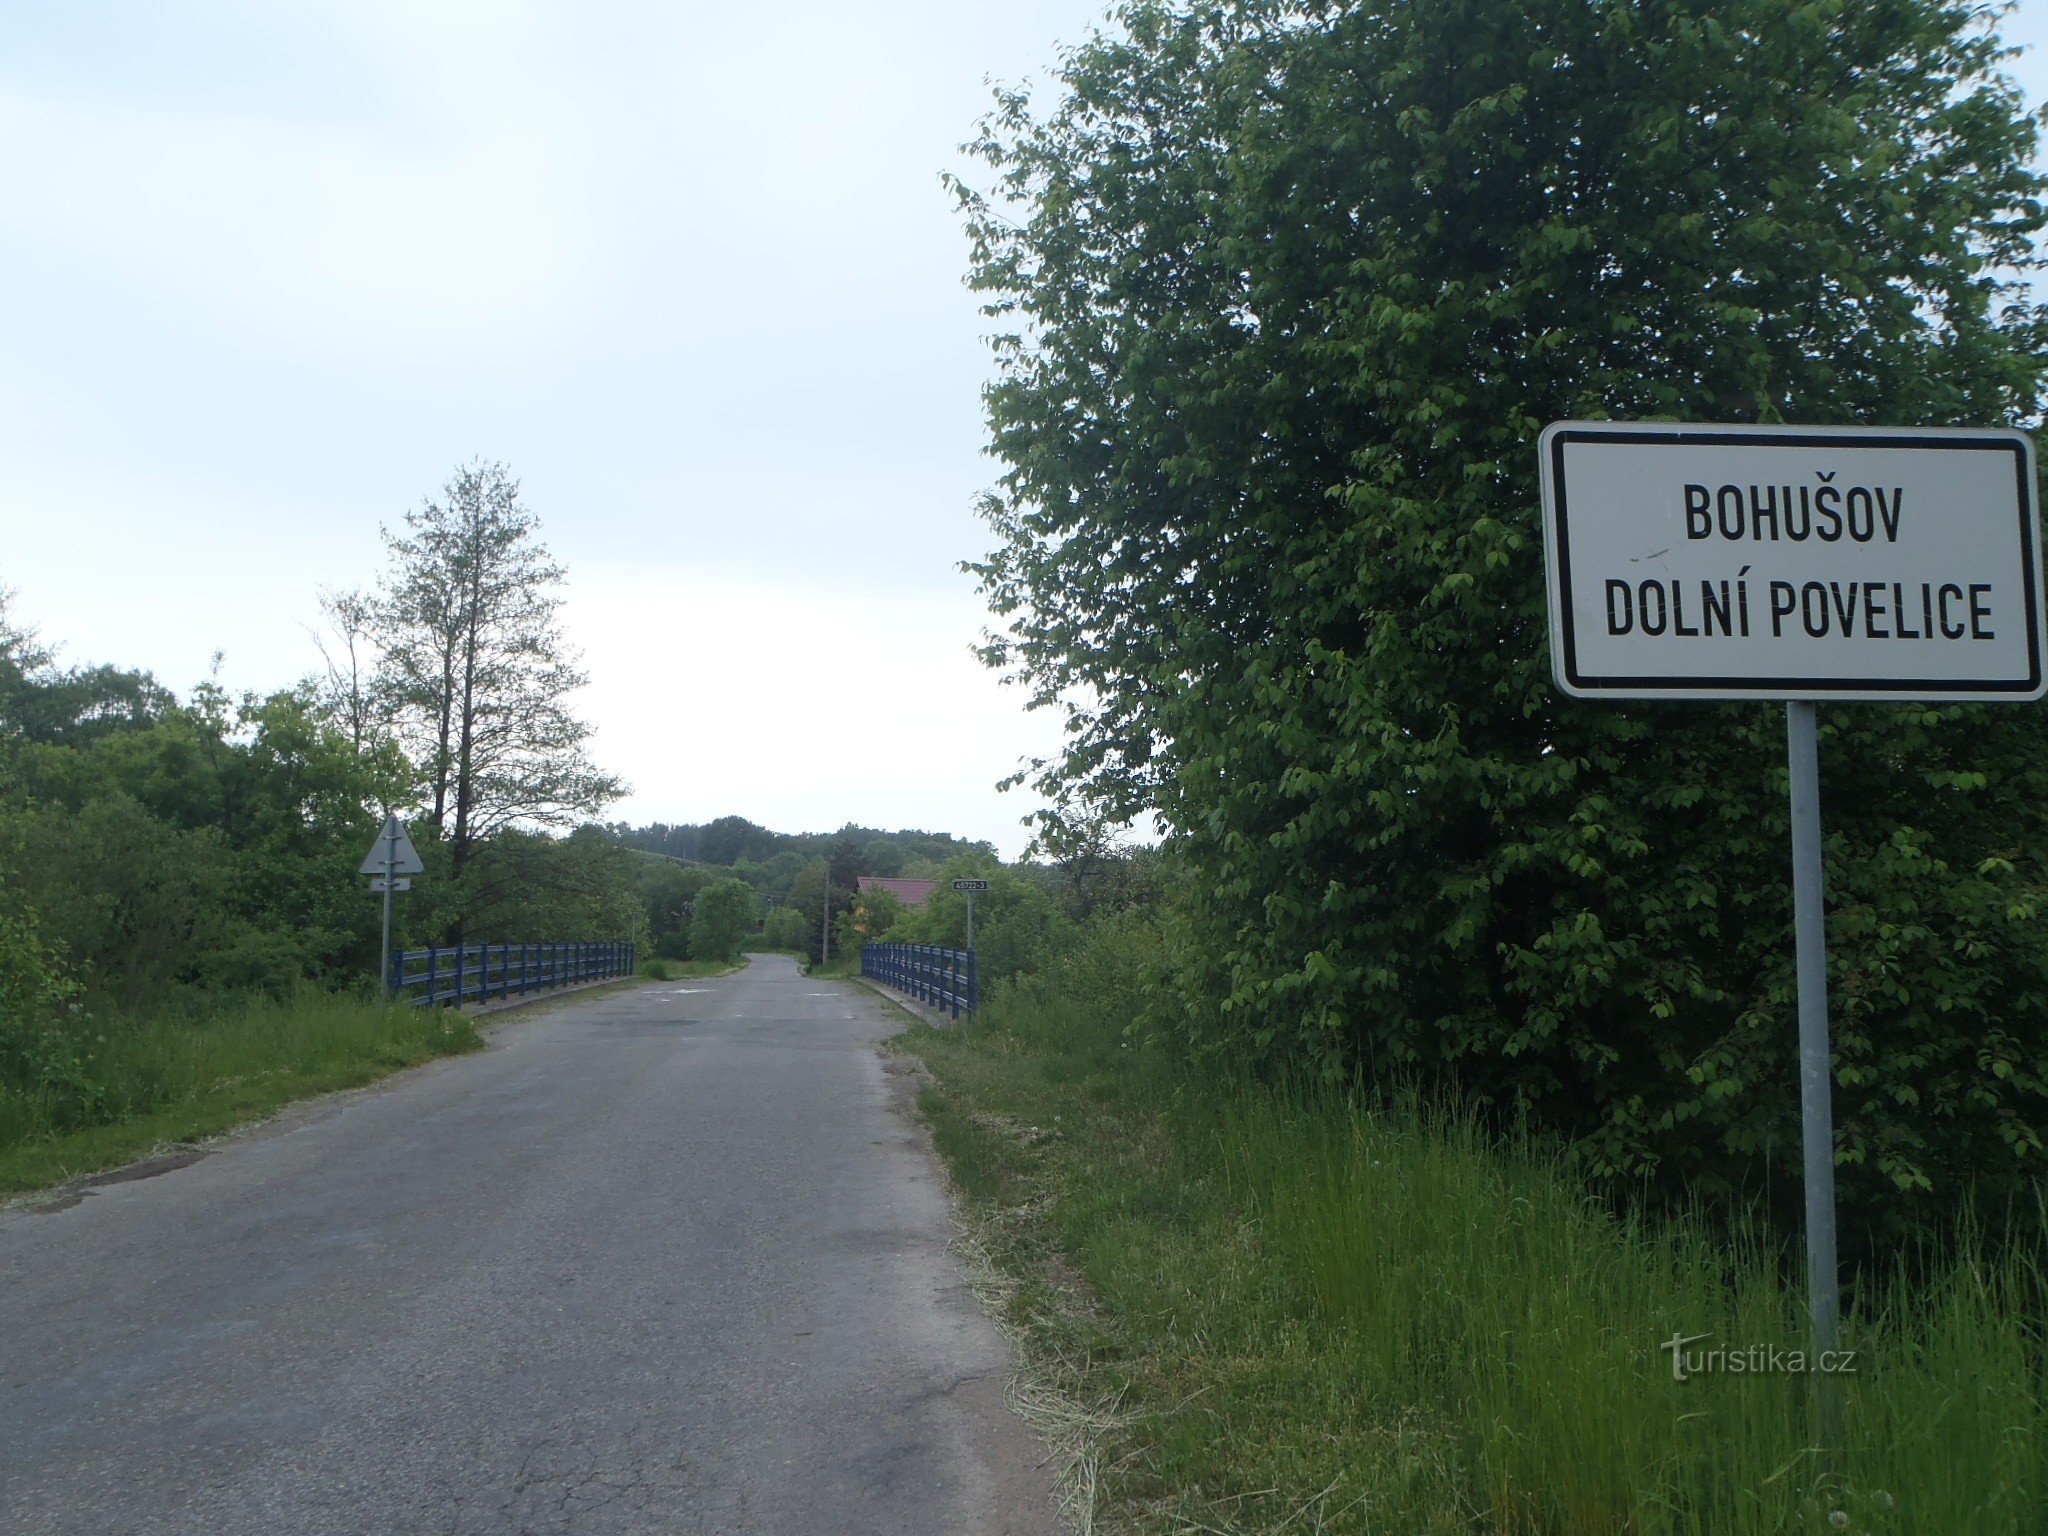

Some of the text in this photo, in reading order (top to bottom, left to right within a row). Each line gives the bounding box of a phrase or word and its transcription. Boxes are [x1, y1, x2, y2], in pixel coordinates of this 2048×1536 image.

[1684, 471, 1902, 542] BOHUŠOV
[1605, 565, 1995, 640] DOLNÍ POVELICE
